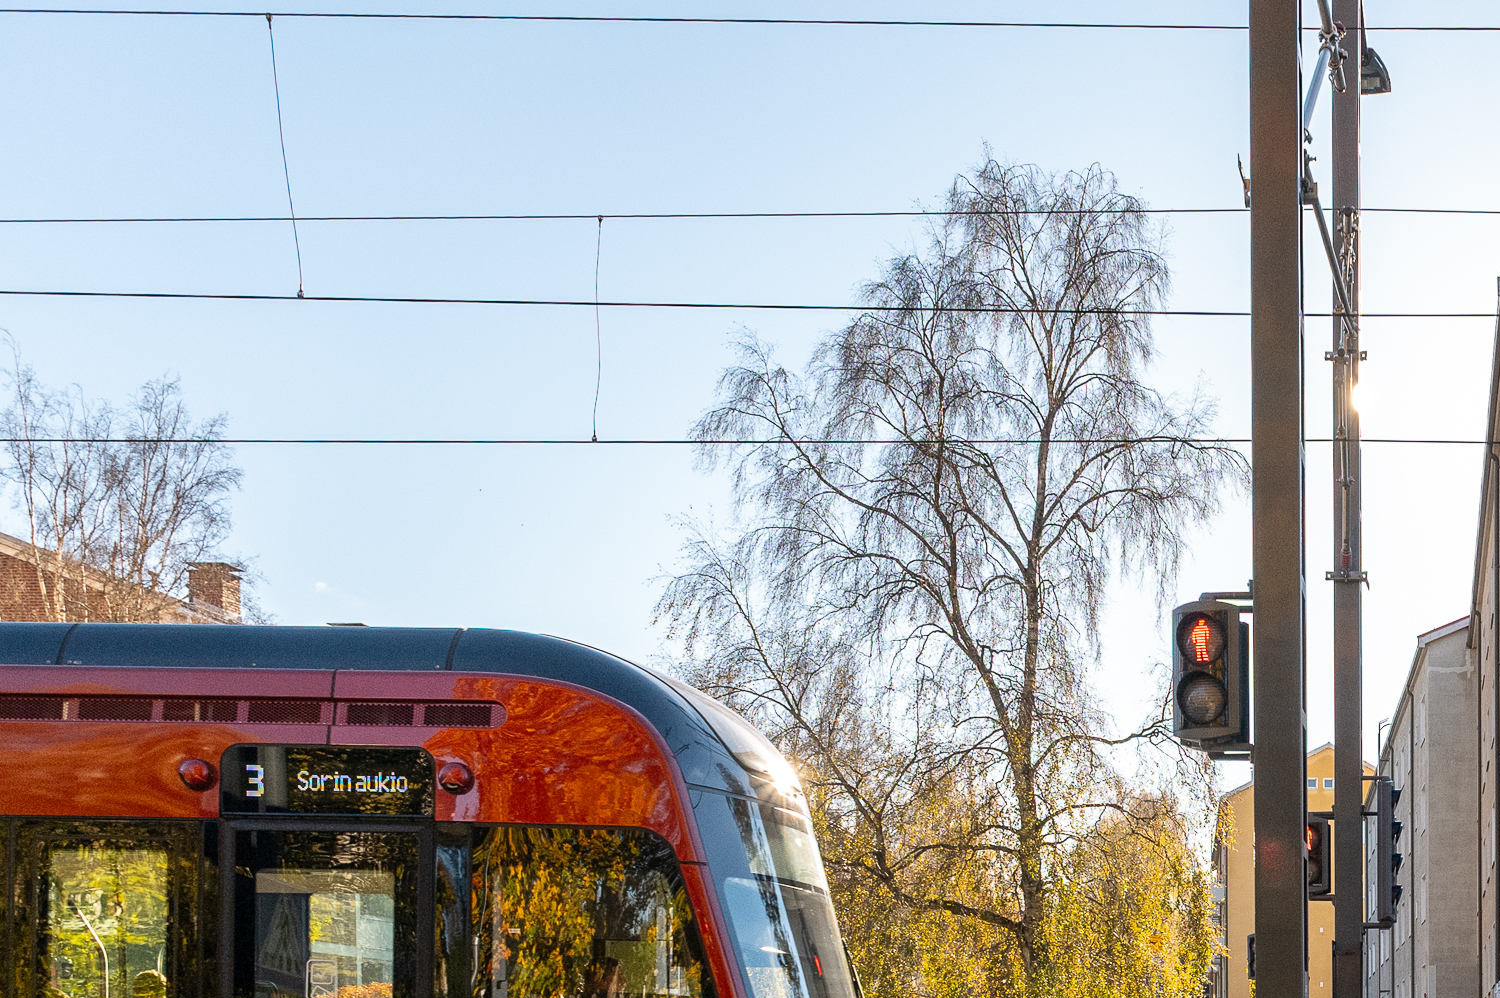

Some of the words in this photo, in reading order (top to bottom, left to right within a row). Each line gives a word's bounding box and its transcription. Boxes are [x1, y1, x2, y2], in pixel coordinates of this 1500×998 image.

[246, 765, 265, 797] 3
[297, 770, 352, 792] Sorin
[355, 772, 408, 793] aukio
